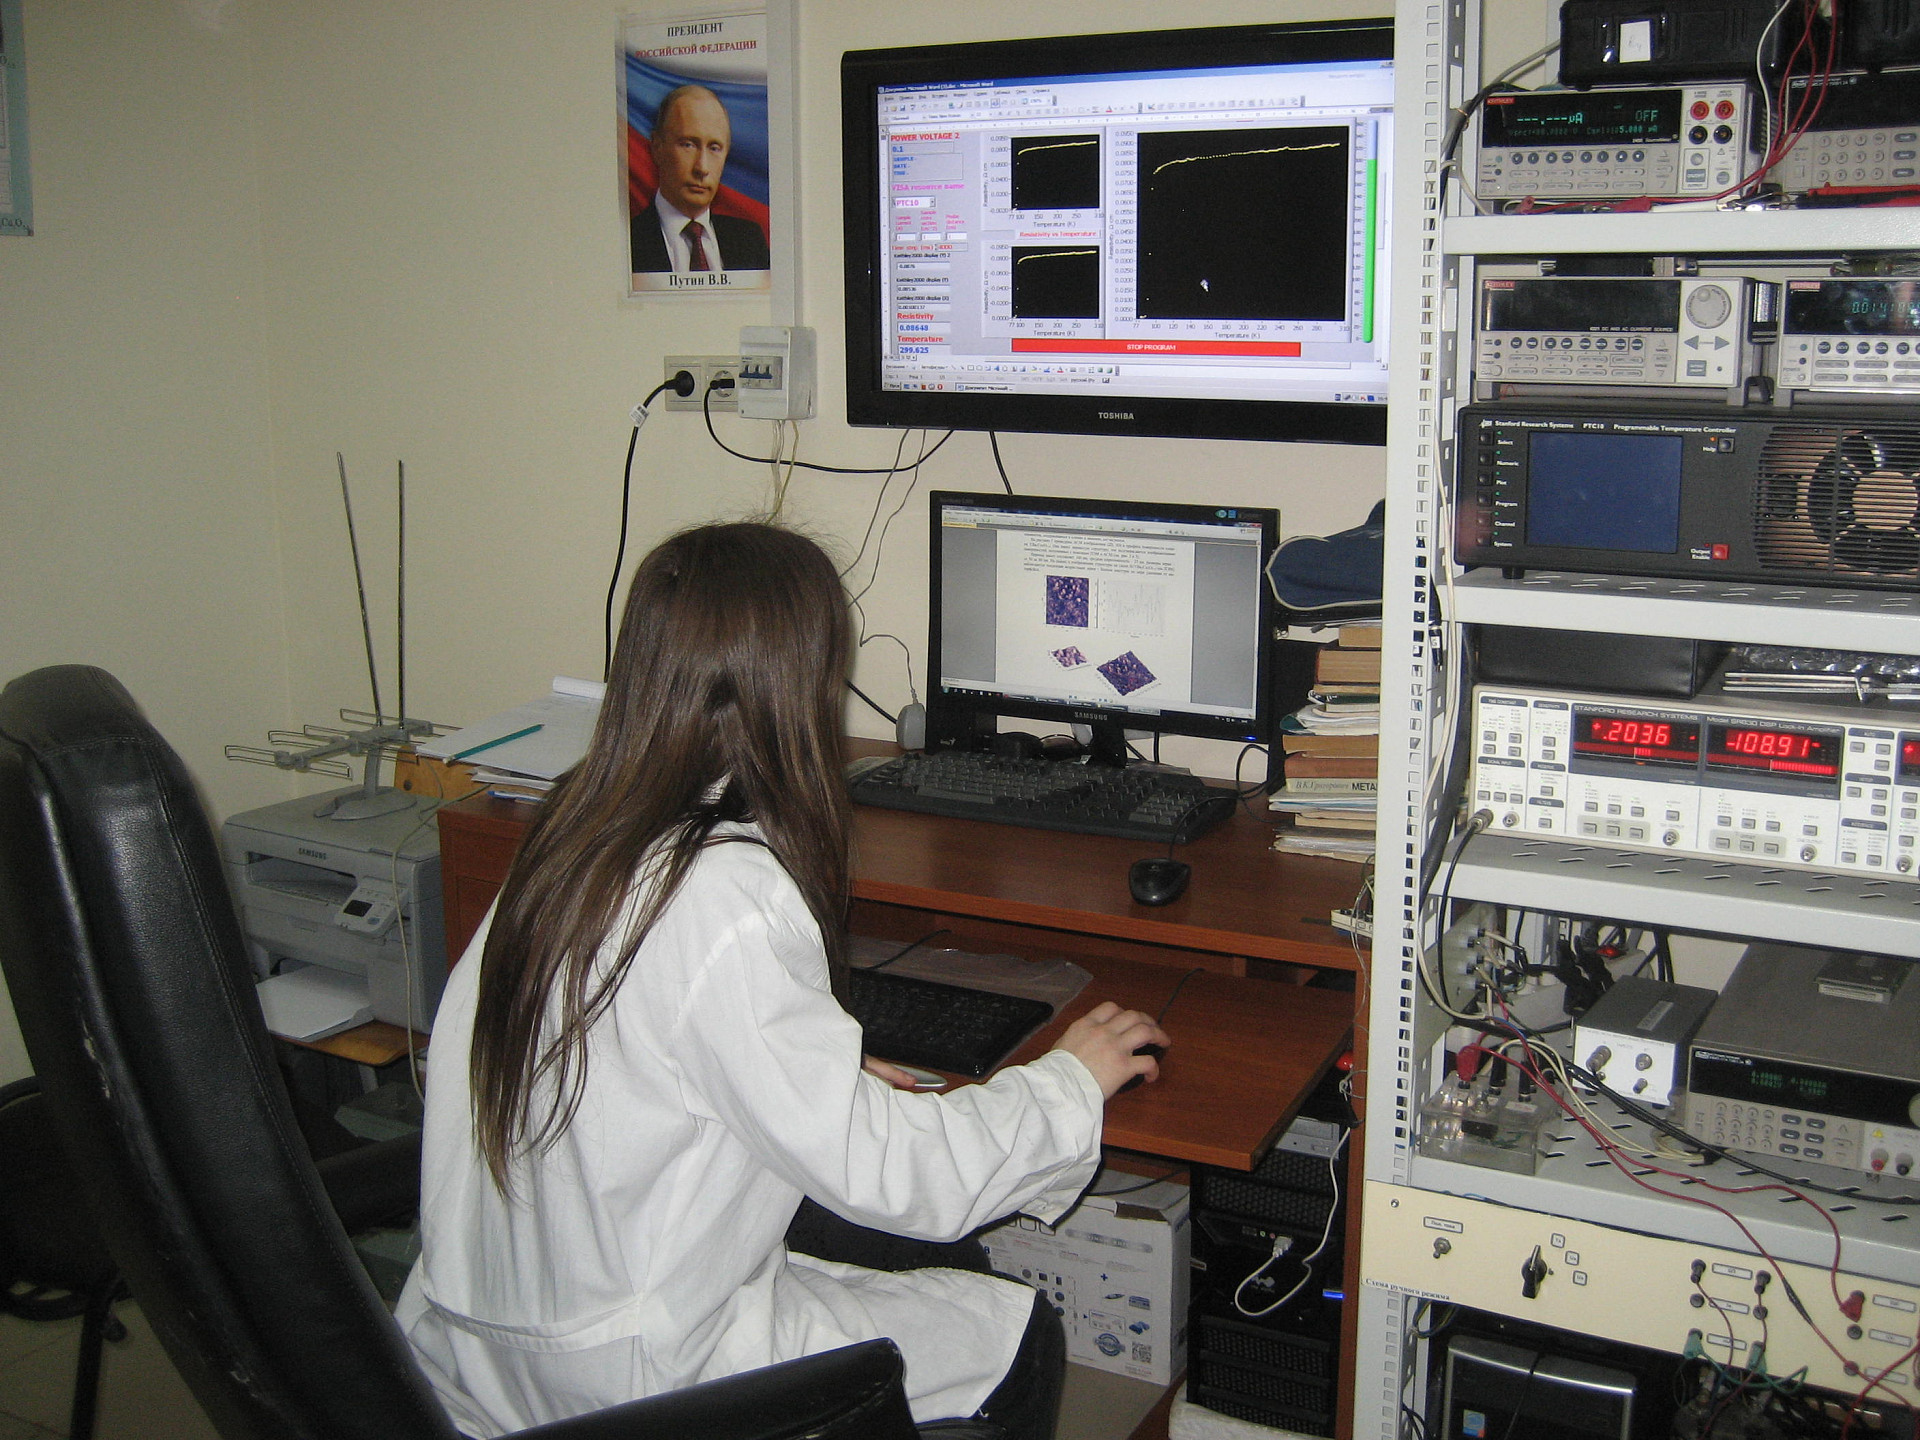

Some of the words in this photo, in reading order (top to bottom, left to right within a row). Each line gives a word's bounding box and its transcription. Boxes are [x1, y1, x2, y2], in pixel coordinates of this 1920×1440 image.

[667, 22, 724, 37] ПРЕЗИДЕНТ
[635, 44, 697, 58] РОССИЙСКОЙ
[700, 41, 757, 53] ФЕДЕРАЦИИ
[1635, 110, 1658, 121] OFF
[669, 274, 704, 288] Путин
[708, 273, 731, 285] В.В.
[1098, 411, 1134, 420] TOSHIBA
[1549, 422, 1574, 430] Systems
[1613, 423, 1659, 432] Programmable
[1660, 425, 1702, 433] Temperature
[1075, 711, 1108, 720] SAMSUNG
[1574, 705, 1616, 714] STANFORD
[1617, 708, 1658, 717] RESEARCH
[1660, 712, 1698, 721] SYSTEMS
[1807, 725, 1840, 733] Amplifier
[299, 847, 327, 860] SAMSUNG
[1366, 1278, 1389, 1288] Схема
[1390, 1283, 1420, 1295] ручного
[1421, 1291, 1450, 1301] режима
